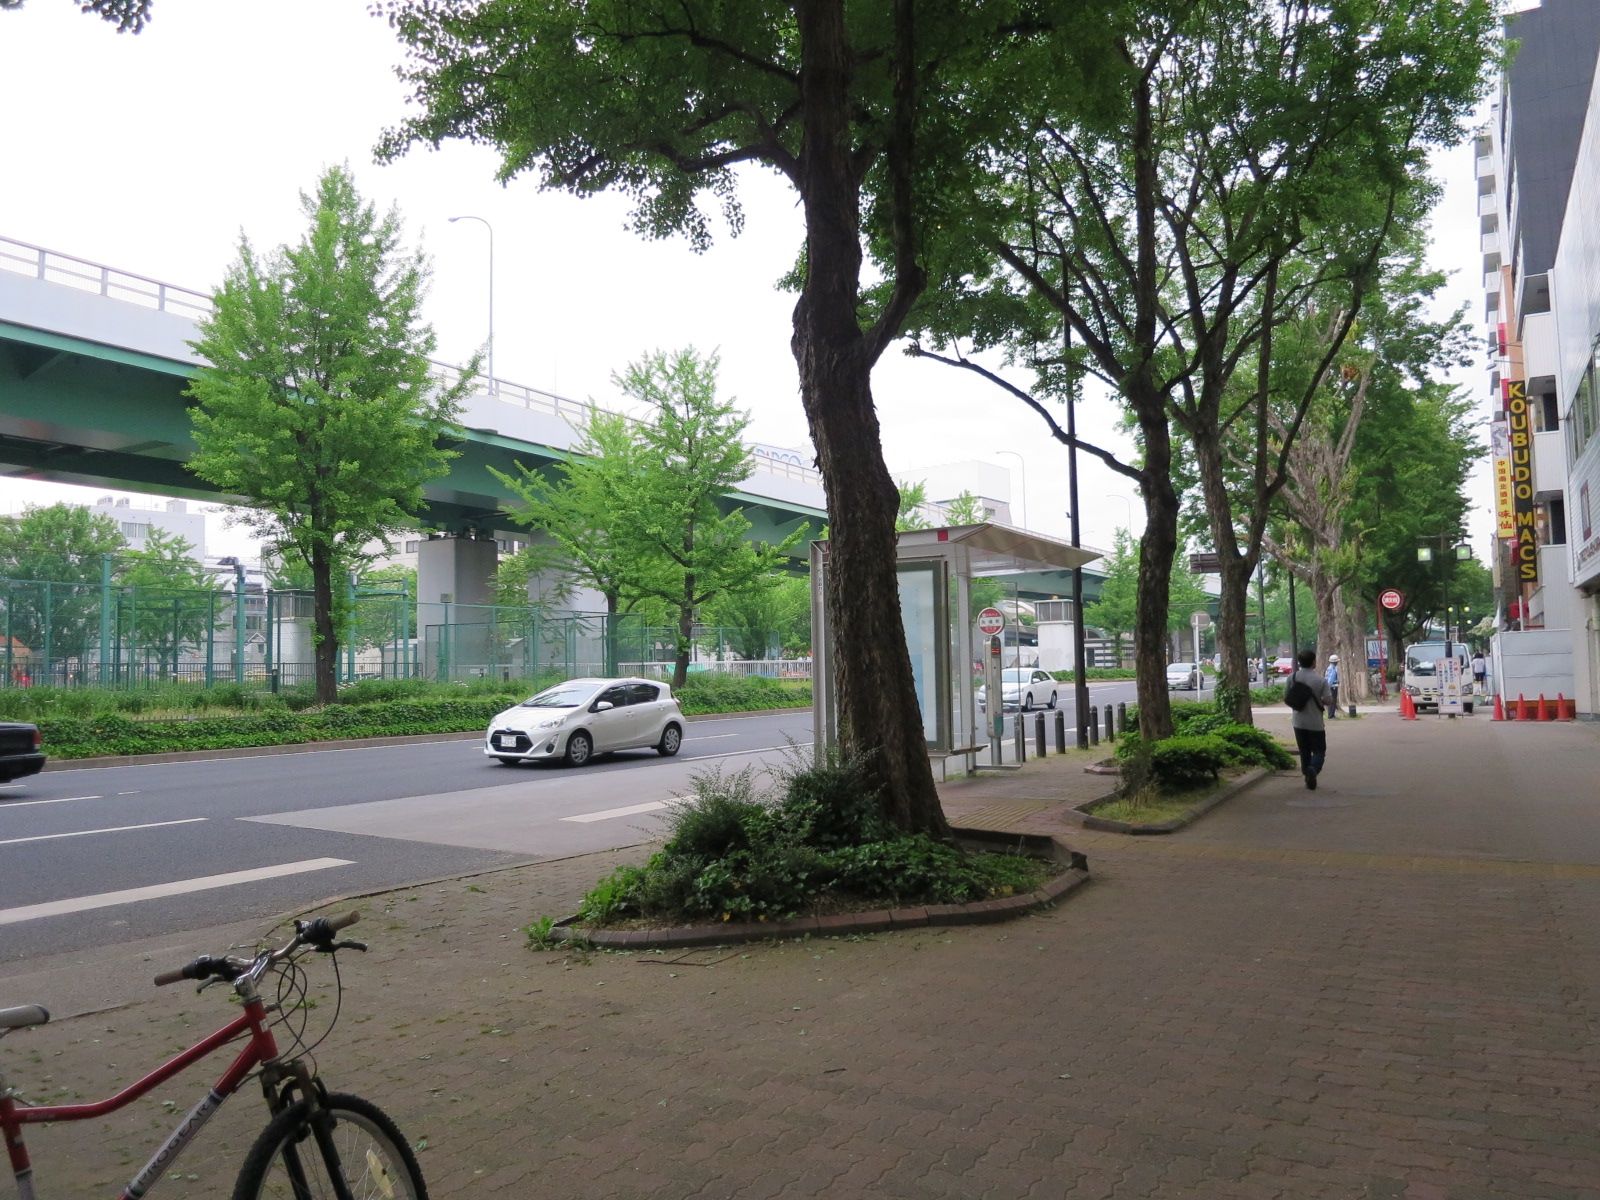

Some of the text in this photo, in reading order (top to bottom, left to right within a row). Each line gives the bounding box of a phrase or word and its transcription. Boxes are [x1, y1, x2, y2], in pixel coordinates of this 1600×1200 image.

[1508, 383, 1536, 579] KOUBUDO MACS
[137, 1102, 209, 1187] PROGEAR
